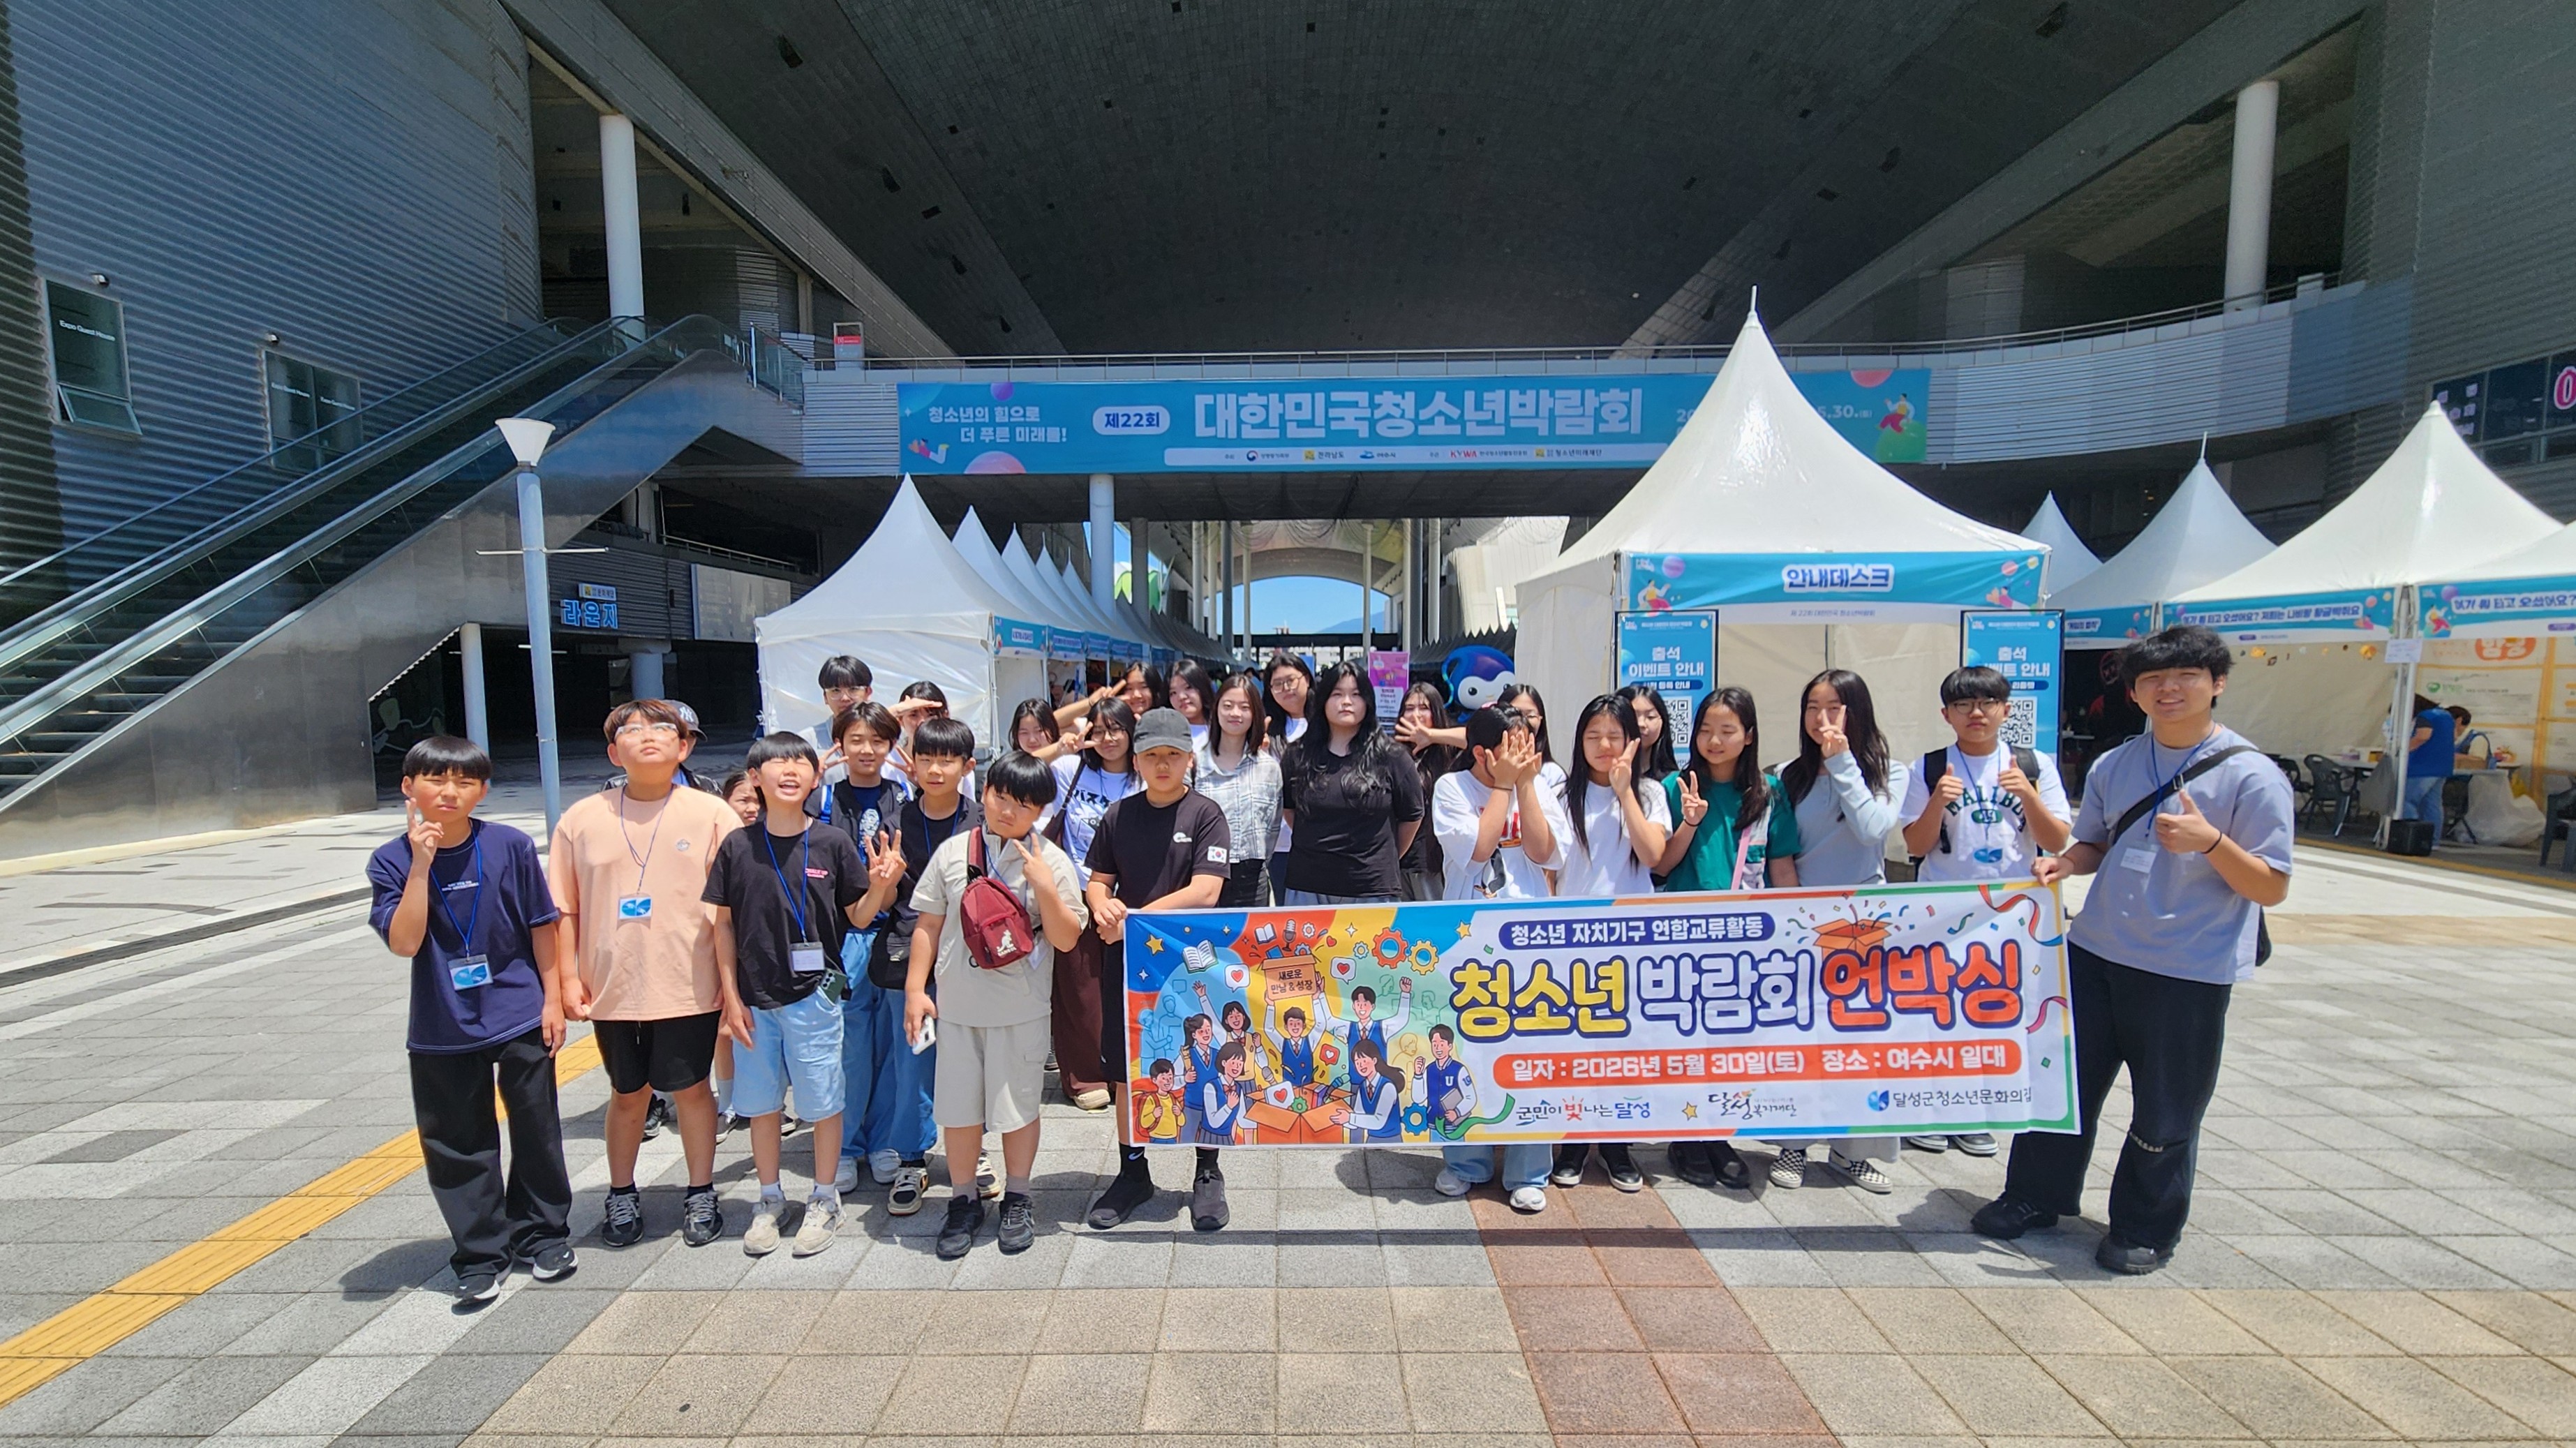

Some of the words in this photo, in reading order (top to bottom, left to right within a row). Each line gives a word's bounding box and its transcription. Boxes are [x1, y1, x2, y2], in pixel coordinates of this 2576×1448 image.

[929, 406, 989, 423] 청소년의
[994, 406, 1041, 423] 힘으로
[1105, 412, 1160, 428] 제22회
[1195, 388, 1642, 438] 대한민국청소년박람회
[960, 427, 975, 442] 더
[980, 427, 1010, 443] 푸른
[1015, 426, 1067, 442] 미래를!
[1450, 450, 1477, 458] KYWA
[1787, 568, 1890, 588] 안내데스크
[2454, 599, 2476, 610] 여기
[2494, 597, 2515, 609] 타고
[561, 599, 618, 629] 라운지
[1628, 663, 1671, 678] 이벤트
[1675, 662, 1704, 677] 안내
[2021, 662, 2050, 677] 안내
[1510, 923, 1566, 946] 청소년
[1572, 920, 1646, 944] 자치기구
[1651, 916, 1764, 941] 연합교류활동
[1279, 969, 1302, 980] 새로운
[1271, 984, 1286, 994] 만남
[1289, 982, 1295, 991] &
[1296, 979, 1313, 991] 성장
[1452, 960, 1629, 1040] 청소년
[1639, 951, 1812, 1033] 박람회
[1822, 941, 2021, 1029] 언박싱
[1512, 1059, 1555, 1081] 일자
[1572, 1055, 1661, 1078] 2026년
[1667, 1054, 1706, 1075] 5월
[1711, 1051, 1805, 1075] 30일(토)
[1822, 1050, 1870, 1071] 장소
[1886, 1047, 1953, 1070] 여수시
[1959, 1045, 2006, 1068] 일대
[1445, 1075, 1454, 1087] U
[1516, 1100, 1562, 1126] 군민이
[1614, 1102, 1651, 1119] 달성
